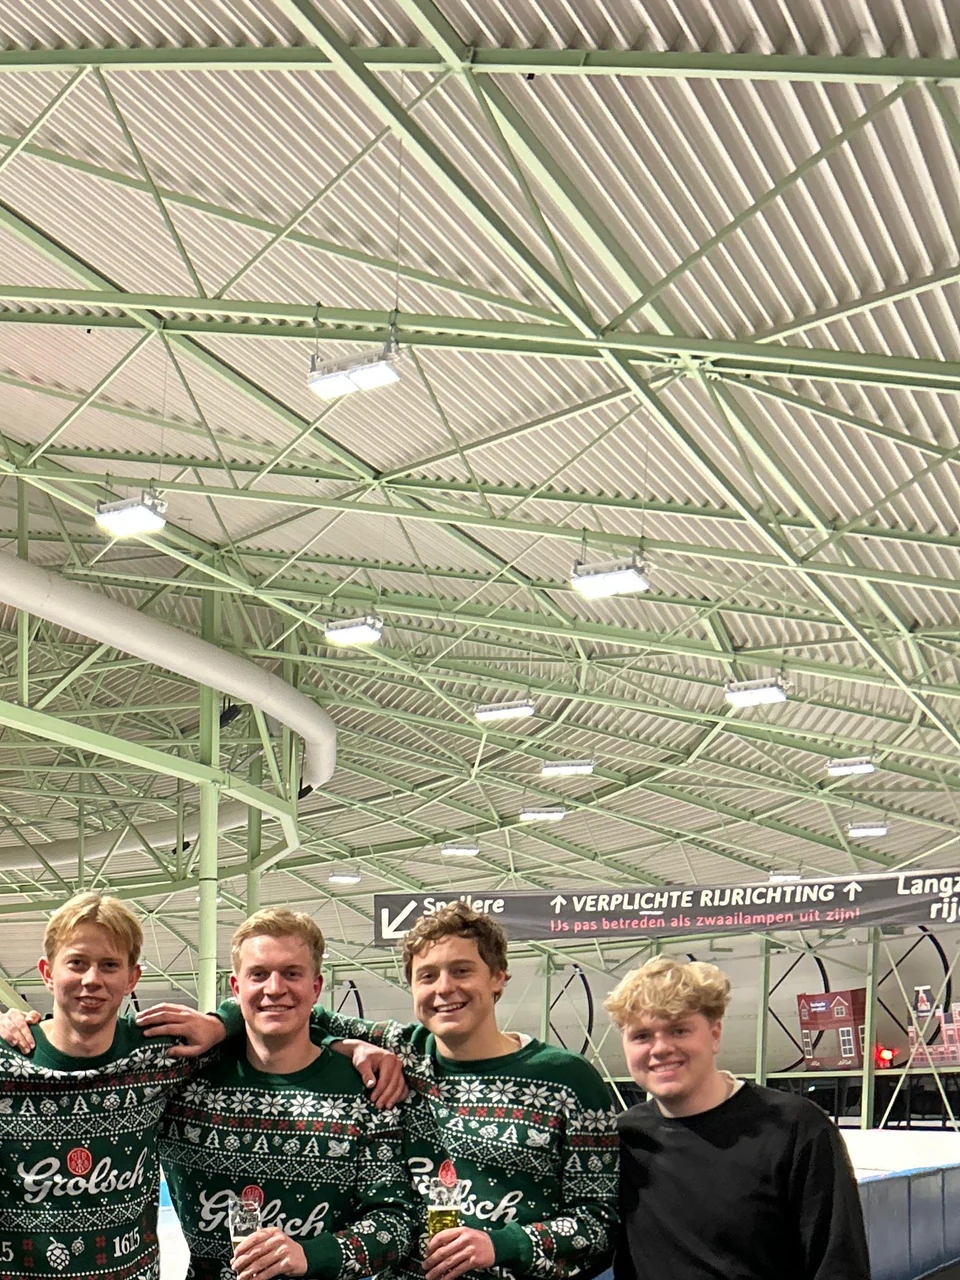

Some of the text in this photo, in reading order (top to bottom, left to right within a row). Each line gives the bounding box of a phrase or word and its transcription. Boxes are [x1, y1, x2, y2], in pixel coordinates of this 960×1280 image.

[423, 895, 505, 915] Snlere
[572, 884, 835, 911] VERPLICHTE RIJRICHTING
[930, 897, 960, 923] rij
[574, 919, 597, 933] pas
[602, 916, 665, 931] betreden
[670, 914, 691, 927] als
[696, 912, 794, 926] zwaailampen
[799, 910, 820, 922] uit
[825, 908, 861, 923] zijn!
[17, 1147, 148, 1204] Grolsch
[198, 1189, 330, 1237] Glsch
[113, 1227, 140, 1257] 1615
